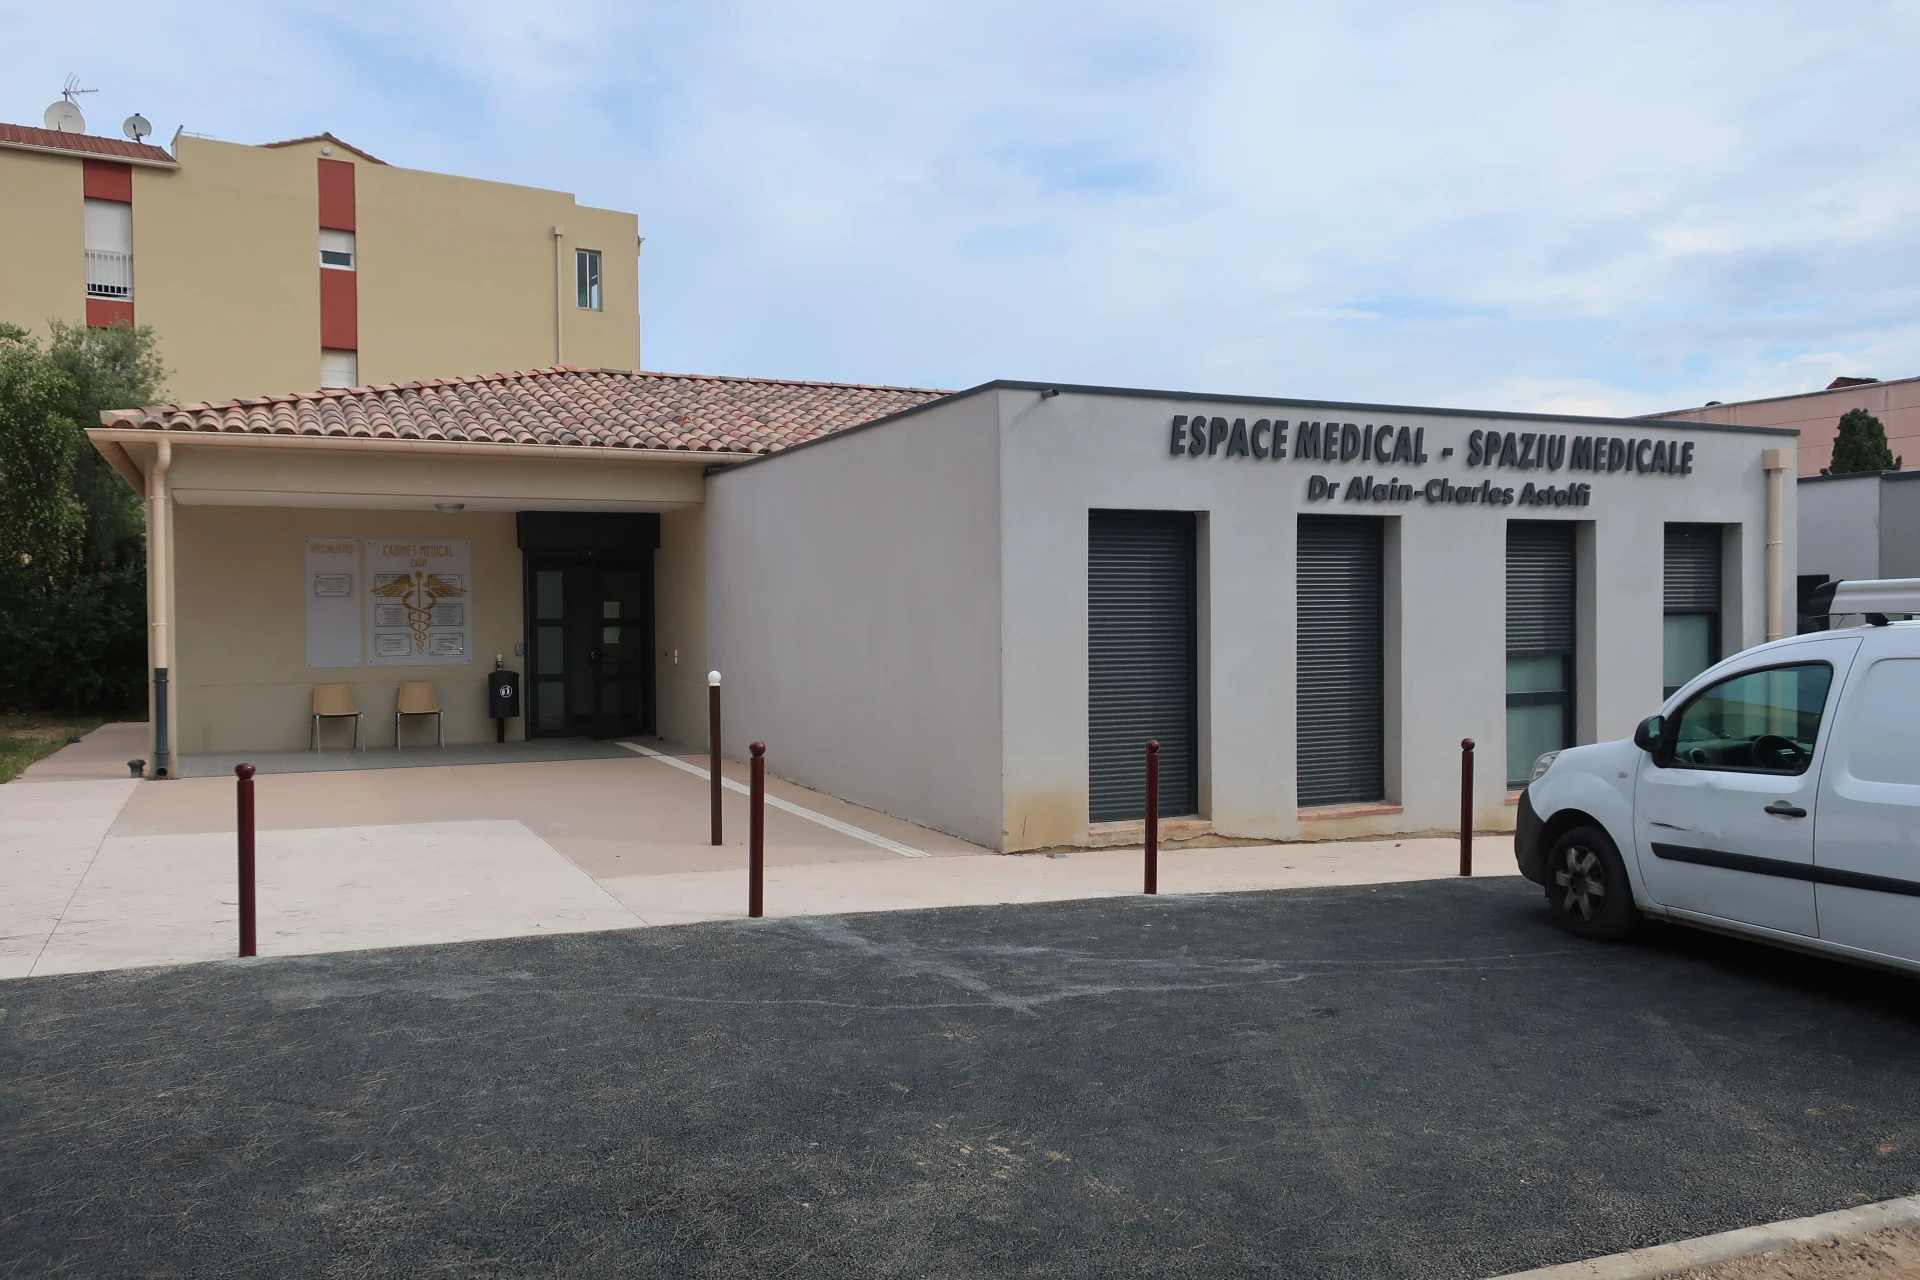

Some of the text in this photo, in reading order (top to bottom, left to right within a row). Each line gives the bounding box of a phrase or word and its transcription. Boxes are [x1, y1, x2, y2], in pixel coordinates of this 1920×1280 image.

[1170, 414, 1289, 458] ESPACE
[1295, 421, 1428, 464] MEDICAL
[1467, 429, 1567, 470] SPAZIU
[1570, 435, 1695, 475] MEDICALE
[1308, 475, 1592, 507] Dr Alain-Charles Astolfi
[382, 545, 454, 558] CABINET MEDICAL
